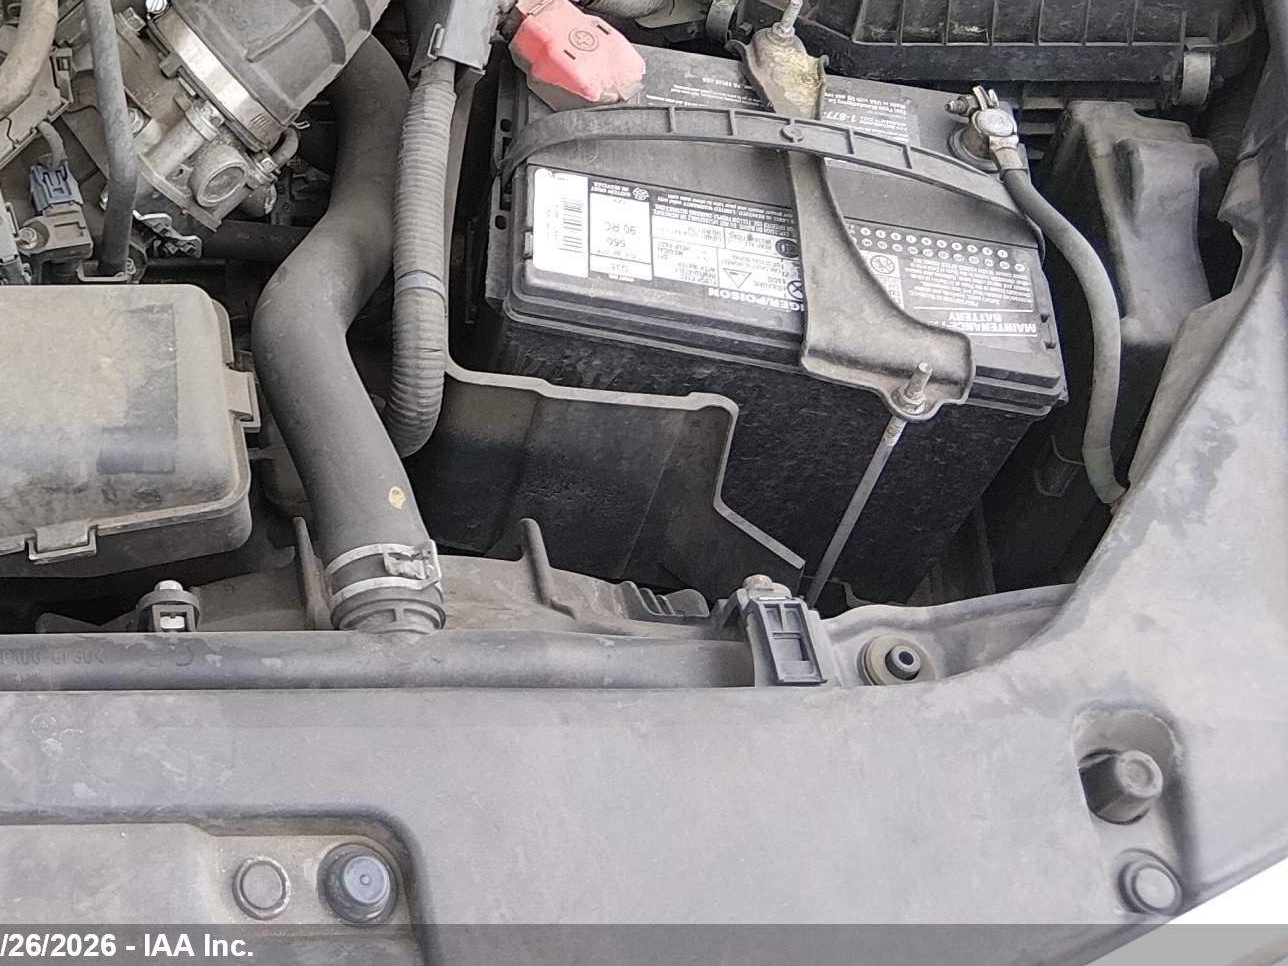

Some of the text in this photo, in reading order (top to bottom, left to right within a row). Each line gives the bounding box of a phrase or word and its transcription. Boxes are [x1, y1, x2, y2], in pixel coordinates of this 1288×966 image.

[822, 110, 857, 123] 1-877-
[708, 287, 804, 312] GER/POISON
[948, 312, 1003, 322] BATTERY
